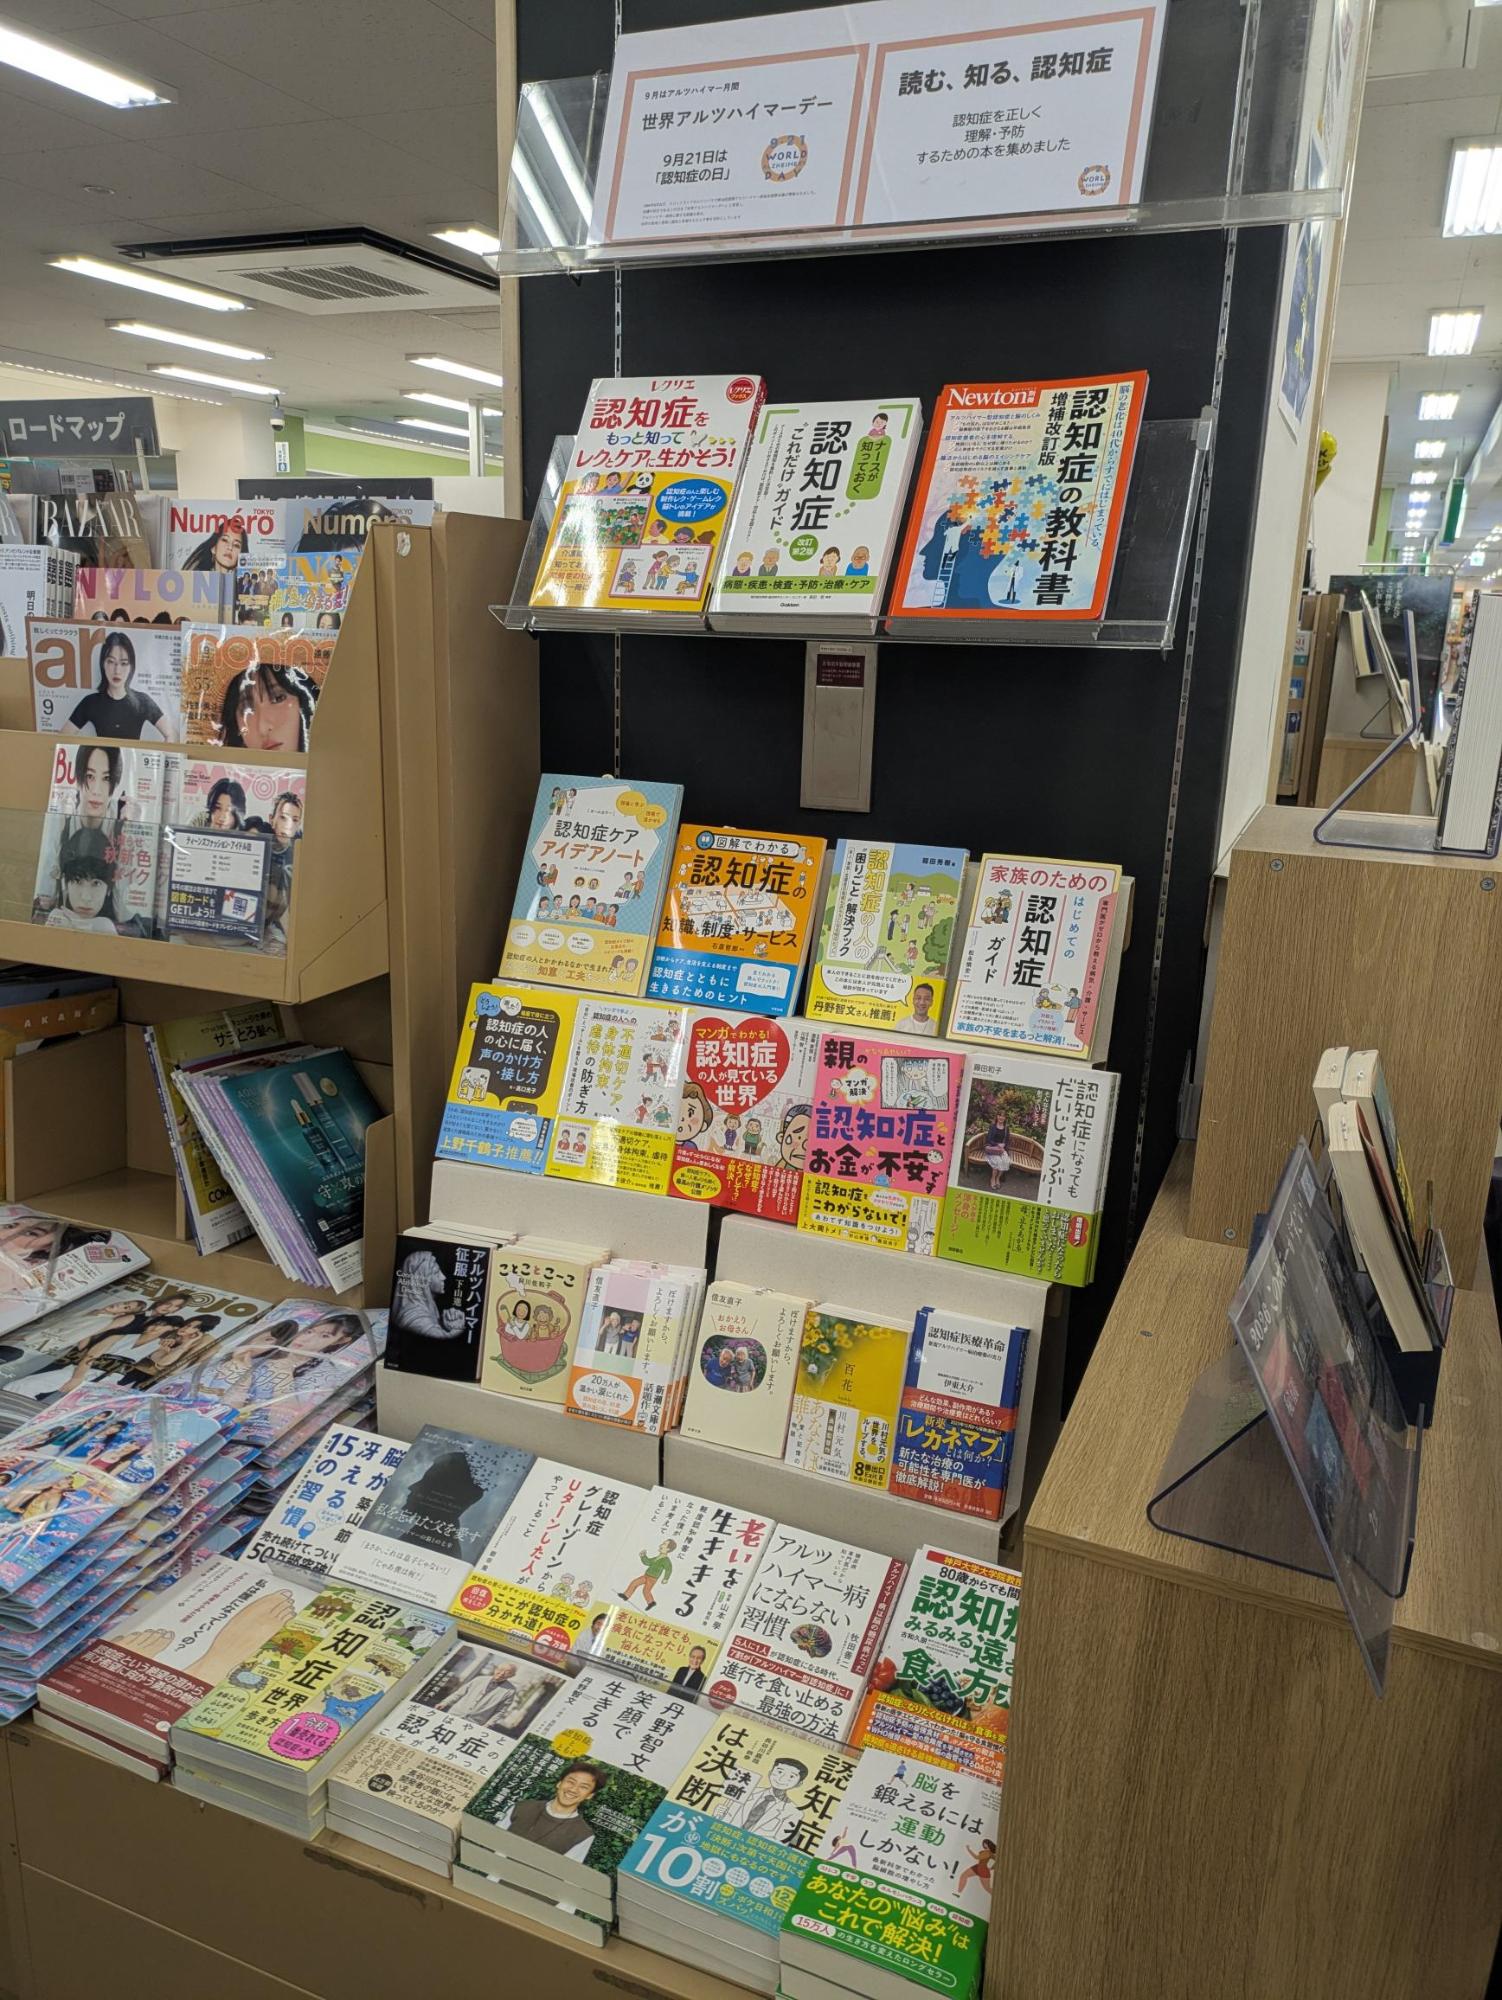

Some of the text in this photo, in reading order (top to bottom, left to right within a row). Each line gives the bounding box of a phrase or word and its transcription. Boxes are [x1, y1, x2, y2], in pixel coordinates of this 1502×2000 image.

[898, 46, 1114, 96] 読む、知る、認知症
[645, 82, 740, 100] 9月はアルツハイマー月間
[642, 95, 833, 131] 世界アルツハイマーデー
[952, 105, 1042, 127] 認知症を正しく
[964, 125, 1026, 143] 理解・予防
[663, 149, 728, 167] 9月21日は
[766, 151, 808, 161] WORLD
[917, 137, 1071, 165] するための本を集めました
[655, 169, 730, 185] 「認知症の日」
[651, 380, 696, 391] レクリエ
[945, 387, 1026, 407] Newton
[9, 411, 125, 442] ロードマップ
[590, 396, 709, 430] 認知症を
[606, 431, 685, 446] もっと知って
[1038, 392, 1068, 466] 増補改訂版
[576, 447, 737, 469] レクとケアに生かそう!
[852, 441, 873, 494] 知っておく
[867, 441, 887, 482] ナースが
[790, 421, 852, 531] 認知症
[1033, 387, 1109, 605] 認知症の教科書
[42, 499, 141, 537] BAZAAR
[170, 507, 275, 536] Numéro TOKYO
[77, 568, 218, 600] NYLON
[723, 578, 870, 591] 病態・疾患・検査・予防・治療・ケア
[34, 627, 107, 690] ar
[42, 699, 54, 716] 9
[554, 819, 639, 845] 認知症ケア
[716, 836, 789, 855] 図解でわかる
[540, 840, 644, 867] アイデアノート
[690, 854, 807, 900] 認知症の
[990, 864, 1108, 892] 家族のための
[853, 848, 890, 960] 認知症の人の
[662, 915, 798, 948] 知識と制度・サービス
[1011, 894, 1057, 988] 認知症
[1064, 895, 1085, 959] はじめての
[984, 936, 1006, 984] ガイド
[652, 966, 730, 987] 認知症とともに
[649, 981, 748, 1005] 生きるためのヒント
[813, 1000, 896, 1022] 丹野智文さん推薦!
[484, 1034, 547, 1054] の心に届く、
[486, 1018, 549, 1039] 認知症の人
[696, 1027, 770, 1040] マンガでわかる!
[956, 1021, 1066, 1046] 家族の不安をまるっと解消!
[479, 1048, 544, 1070] 声のかけ方
[695, 1041, 778, 1068] 認知症
[824, 1039, 868, 1068] 親の
[973, 1063, 1002, 1075] 藤田和子
[698, 1069, 778, 1084] の人が見ている
[715, 1084, 758, 1106] 世界
[816, 1101, 946, 1147] 認知症と
[1067, 1080, 1099, 1199] 認知症になっても
[1042, 1078, 1077, 1204] だいじょうぶ!
[809, 1143, 943, 1194] お金が不安です
[812, 1199, 907, 1226] こわがらないで!
[815, 1215, 899, 1235] あわてず知識をつけよう!
[454, 1248, 470, 1278] 征服
[499, 1263, 575, 1287] ことことこーこ
[465, 1249, 486, 1344] アルツハイマー
[717, 1314, 747, 1325] おかえり
[719, 1324, 750, 1335] お母さん
[767, 1307, 786, 1395] よろしくお願いします。
[784, 1310, 800, 1365] ぼけますから、
[928, 1326, 1005, 1351] 認知症医療革命
[579, 1384, 629, 1401] 温かい涙にくれた
[591, 1374, 621, 1388] 20万人が
[842, 1363, 856, 1392] 百花
[943, 1379, 975, 1393] 伊東大介
[649, 1384, 665, 1432] 新潮文庫の
[910, 1400, 1003, 1426] 治療期間や治療費はどれくらい?
[918, 1394, 995, 1416] どんな効果、副作用がある?
[834, 1411, 848, 1459] 川村元気
[925, 1416, 945, 1430] 新薬
[366, 1447, 407, 1491] 脳が
[899, 1446, 964, 1472] 新たな治療の
[945, 1448, 993, 1468] とは何か?
[280, 1433, 359, 1528] 15の習慣
[326, 1441, 383, 1510] 冴える
[895, 1471, 945, 1493] 徹底解説!
[898, 1461, 987, 1489] 可能性を専門医が
[522, 1475, 563, 1538] やっていること
[585, 1490, 620, 1537] 認知症
[651, 1494, 669, 1523] いること
[659, 1497, 682, 1535] いま考えて
[673, 1502, 695, 1537] なった僕が
[517, 1479, 581, 1585] Uターンした人が
[537, 1486, 602, 1592] グレーゾーンから
[674, 1508, 737, 1617] 生ききる
[722, 1518, 767, 1590] 老いを
[772, 1535, 832, 1565] アルツ
[762, 1563, 871, 1609] ハイマー病
[487, 1607, 543, 1633] 分かれ道!
[494, 1593, 580, 1631] ここが認知症の
[752, 1583, 851, 1627] にならない
[616, 1611, 692, 1645] 老いれば誰でも、
[741, 1605, 790, 1641] 習慣
[287, 1601, 400, 1691] 認知症
[611, 1621, 688, 1657] 病気になったり、
[734, 1637, 768, 1655] 5人に1人
[262, 1686, 309, 1712] 世界
[564, 1676, 593, 1706] 丹野智文
[582, 1680, 626, 1728] 生きる
[720, 1660, 843, 1717] 進行を食い止める
[243, 1710, 283, 1730] 歩き方
[407, 1703, 506, 1747] ボクはやっと
[612, 1690, 653, 1740] 笑顔で
[756, 1695, 839, 1739] 最強の方法
[379, 1728, 489, 1776] ことがわかった
[397, 1713, 500, 1761] 認知症の
[561, 1728, 595, 1746] 認知症
[623, 1702, 685, 1773] 丹野智文
[675, 1723, 750, 1812] は決断
[728, 1769, 752, 1801] 決断
[911, 1772, 961, 1801] 脳を
[780, 1753, 858, 1857] 認知症
[872, 1784, 985, 1836] 鍛えるには
[659, 1811, 703, 1834] が
[891, 1815, 946, 1847] 運動
[635, 1833, 720, 1901] 10割
[859, 1830, 960, 1880] しかない!
[795, 1916, 831, 1936] 15万人
[817, 1902, 943, 1963] これで解決!
